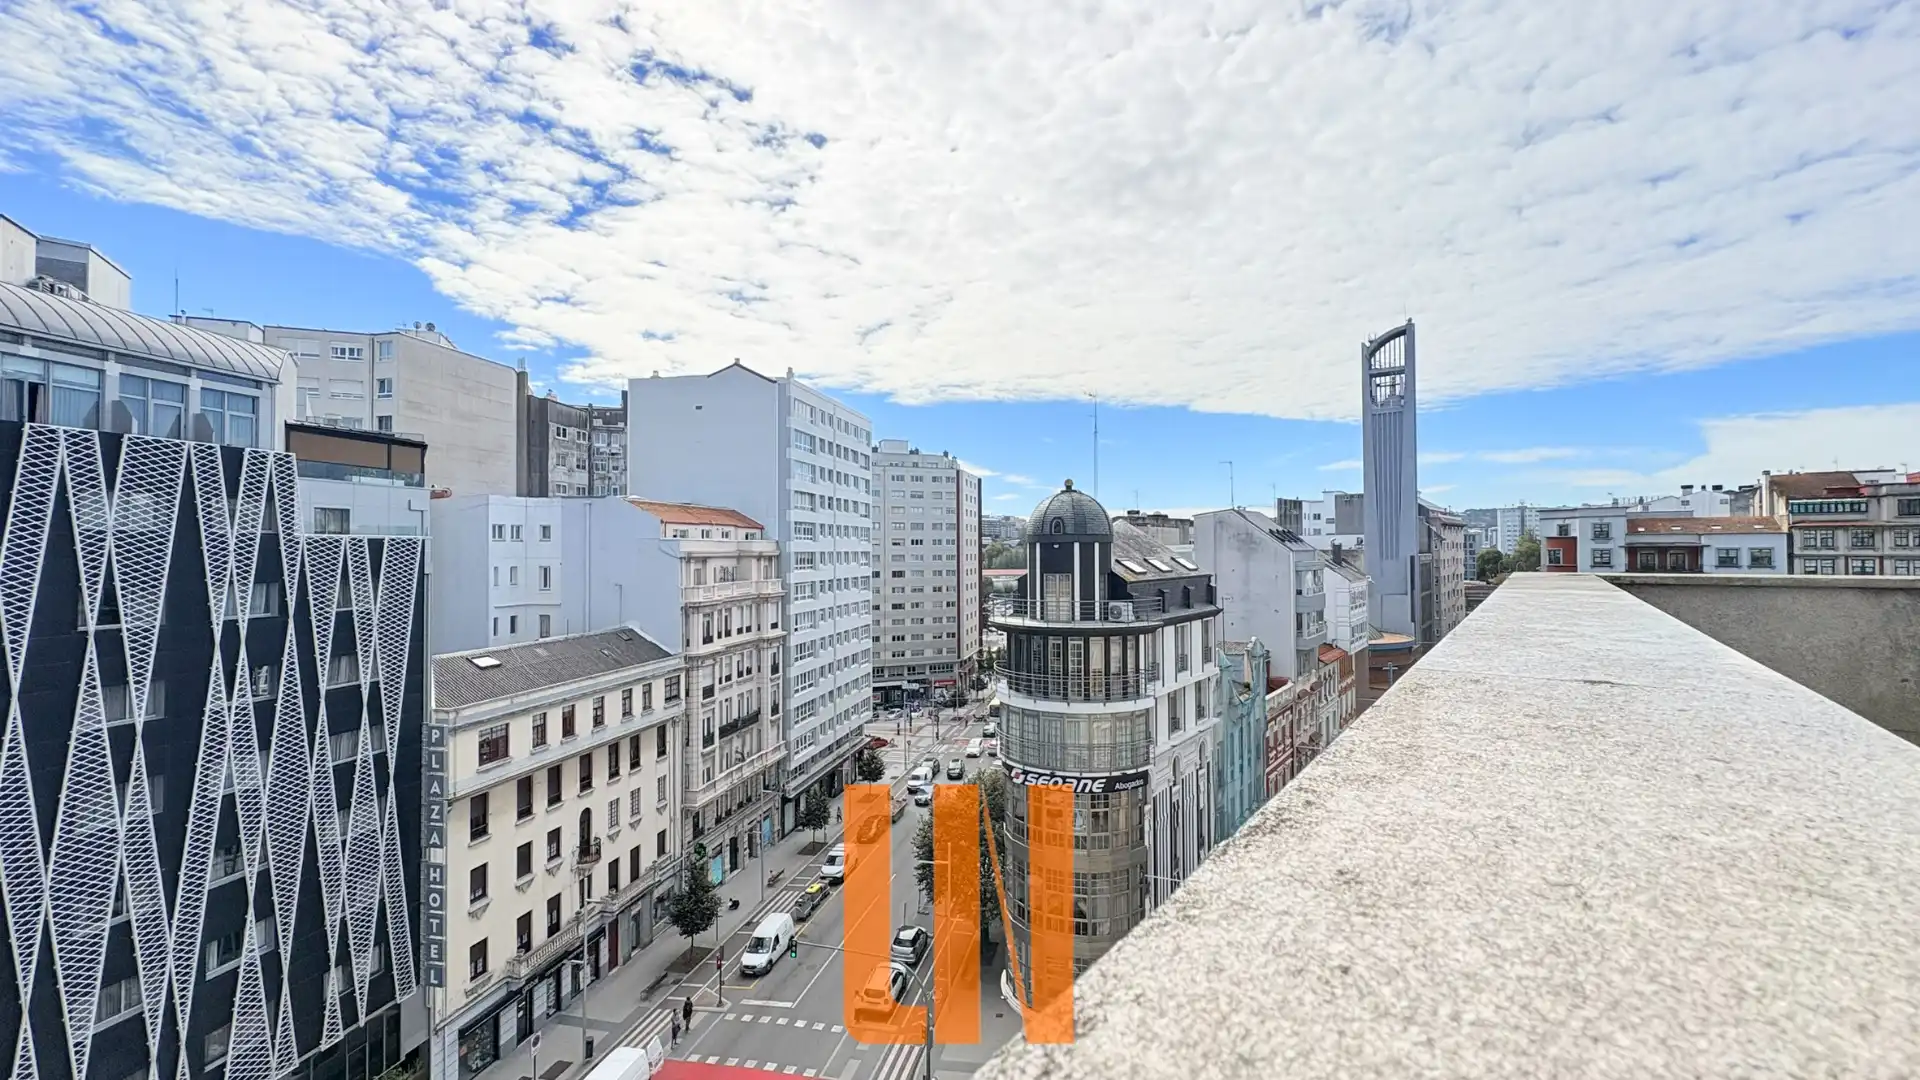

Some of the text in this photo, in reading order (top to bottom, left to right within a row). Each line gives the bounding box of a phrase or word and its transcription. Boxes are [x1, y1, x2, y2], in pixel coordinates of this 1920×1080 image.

[1114, 778, 1144, 791] Abogados
[428, 728, 442, 985] PLAZA HOTEL
